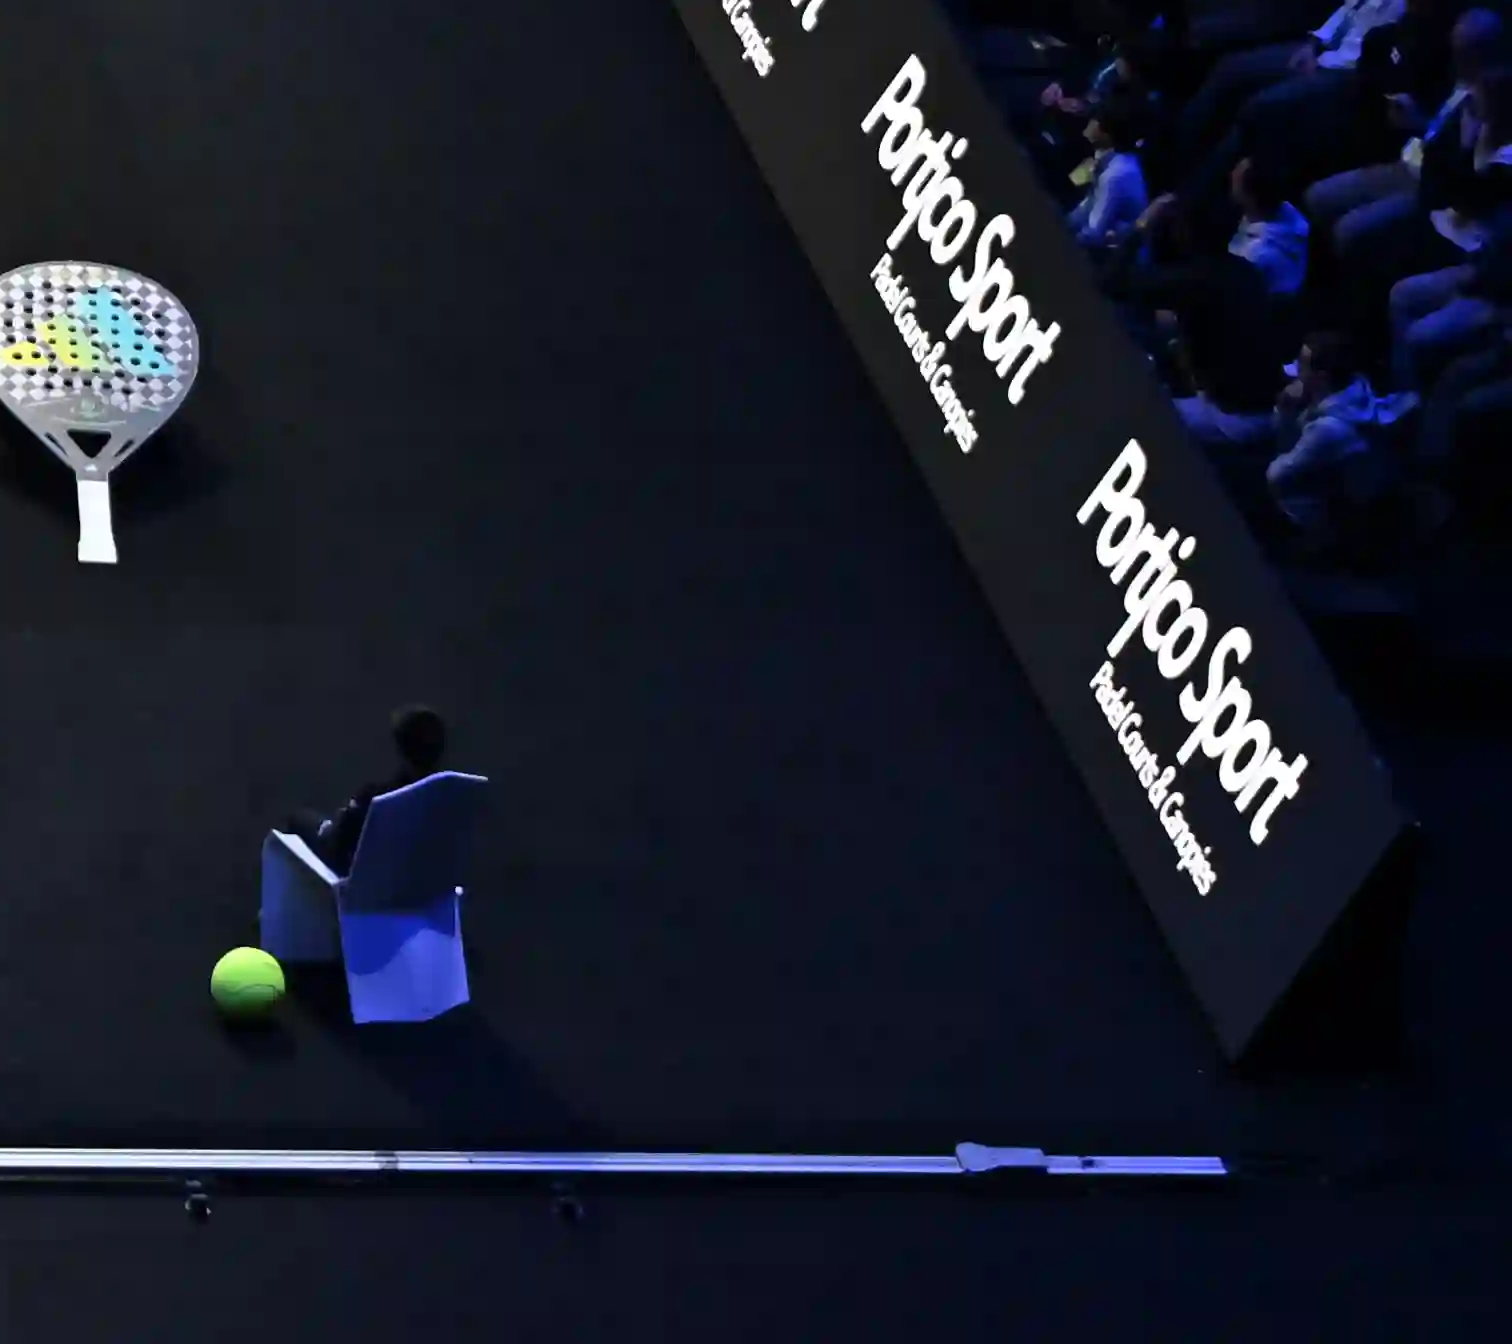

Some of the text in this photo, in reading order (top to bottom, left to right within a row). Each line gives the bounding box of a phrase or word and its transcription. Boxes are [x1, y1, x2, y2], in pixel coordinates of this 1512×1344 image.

[861, 54, 1061, 405] Portico Sport
[1076, 438, 1309, 845] Portico Sport
[1089, 661, 1135, 732] Padel
[1117, 712, 1161, 788] Courts
[1160, 792, 1217, 896] Canopies
